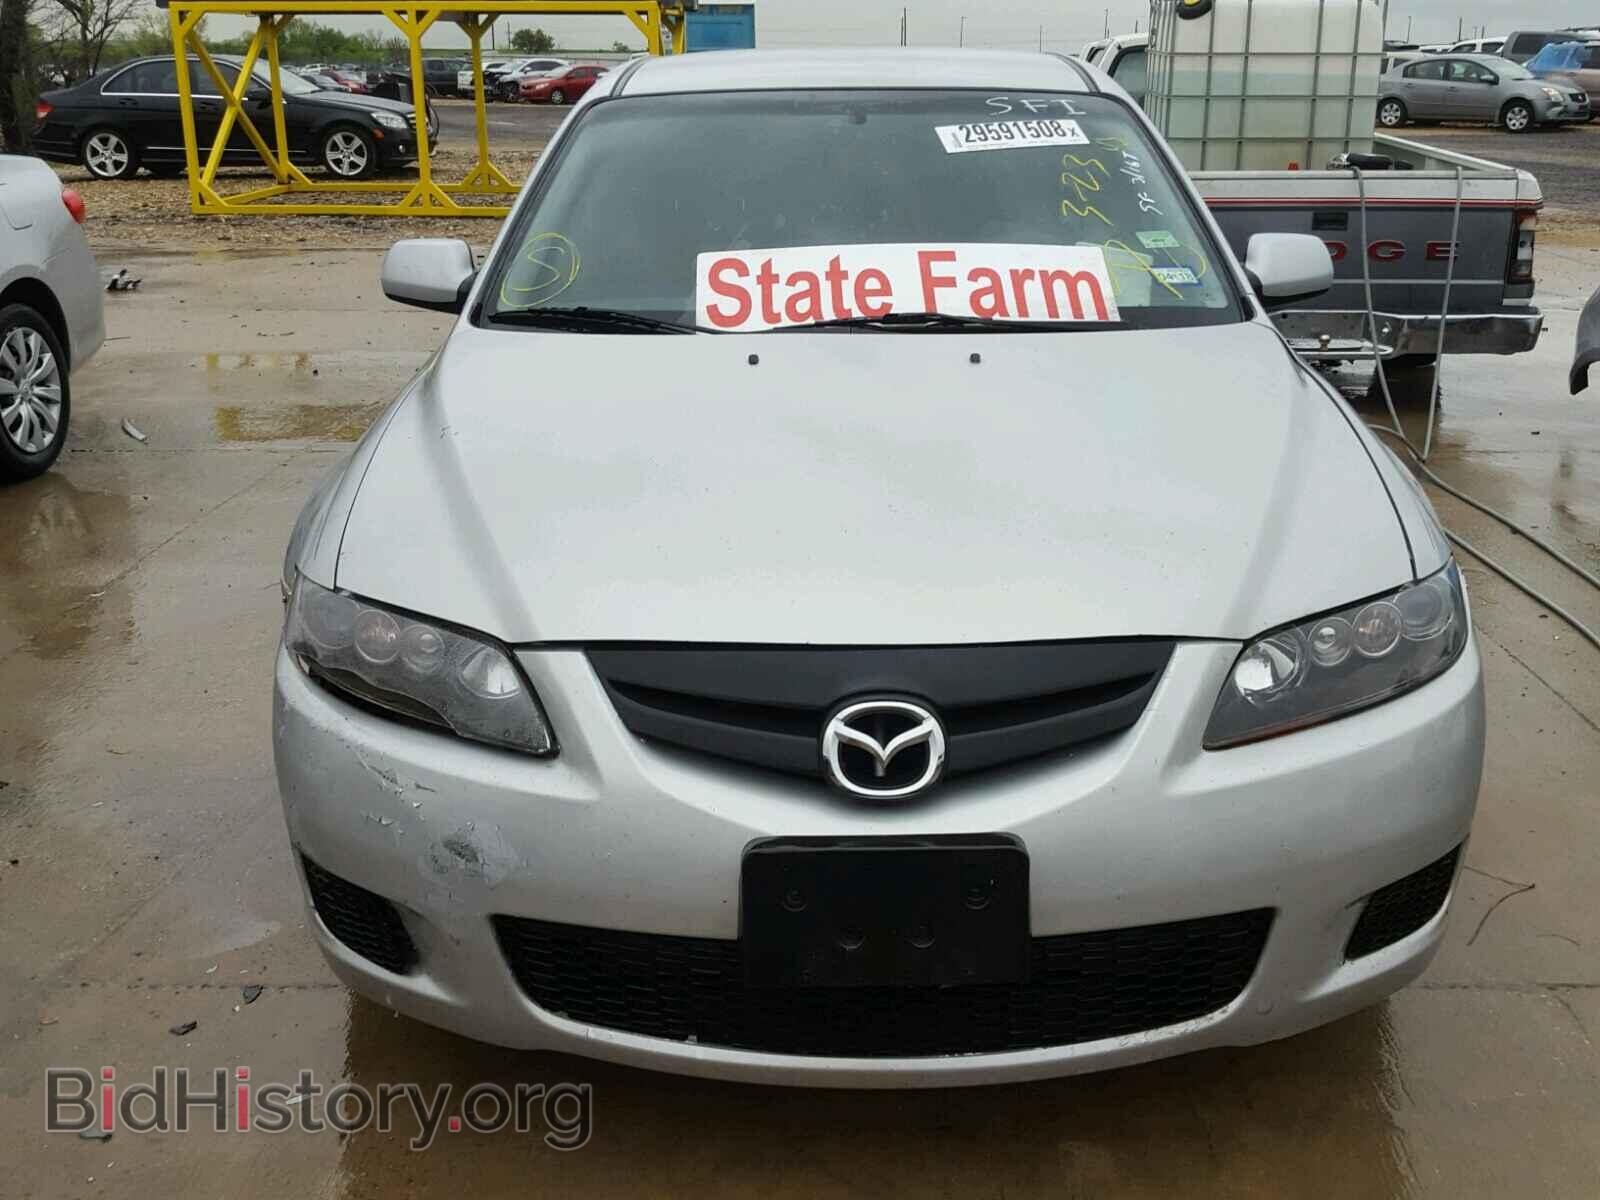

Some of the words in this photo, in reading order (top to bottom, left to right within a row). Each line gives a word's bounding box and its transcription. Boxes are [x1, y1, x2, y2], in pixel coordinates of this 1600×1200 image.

[958, 120, 1067, 143] 29591508
[1322, 240, 1462, 261] DGE
[705, 254, 894, 328] State
[917, 250, 1110, 321] Farm
